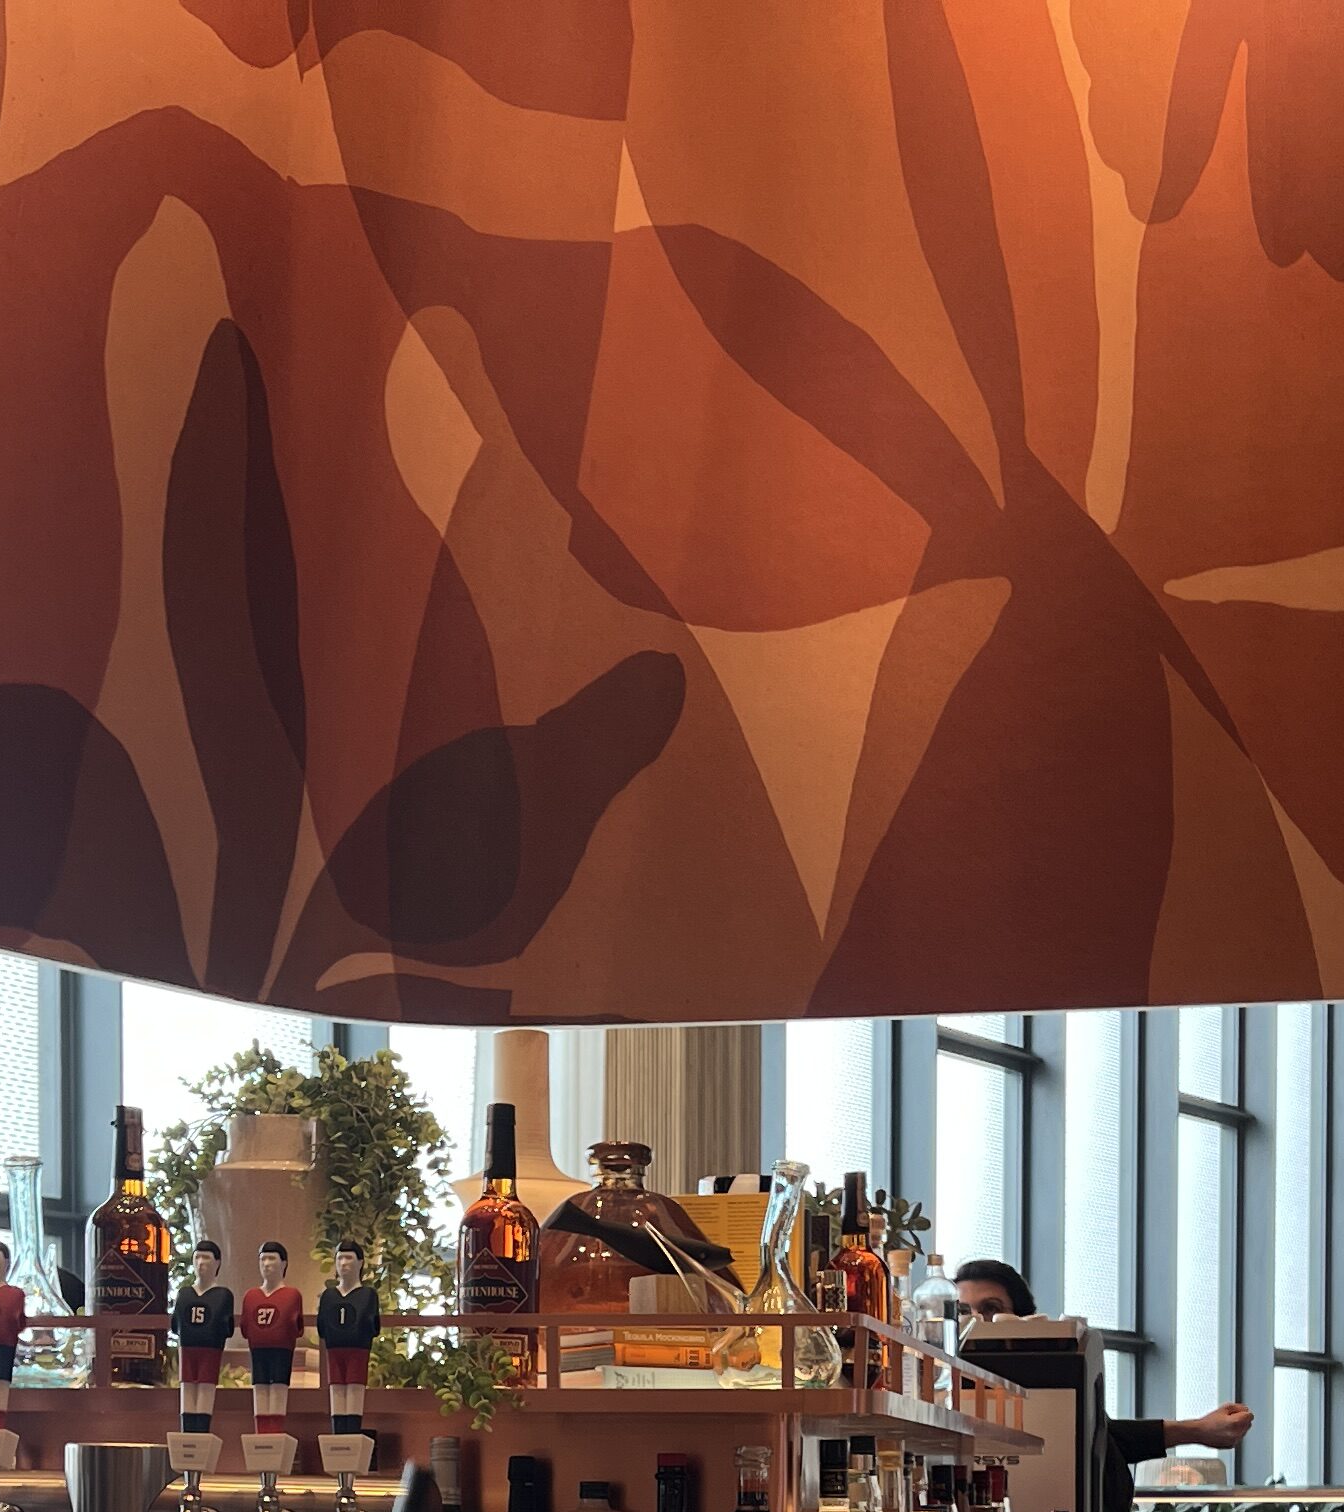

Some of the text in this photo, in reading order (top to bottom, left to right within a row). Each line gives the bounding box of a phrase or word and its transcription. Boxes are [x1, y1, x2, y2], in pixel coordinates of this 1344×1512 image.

[191, 1306, 205, 1323] 15
[257, 1308, 275, 1325] 27
[339, 1307, 345, 1324] 1
